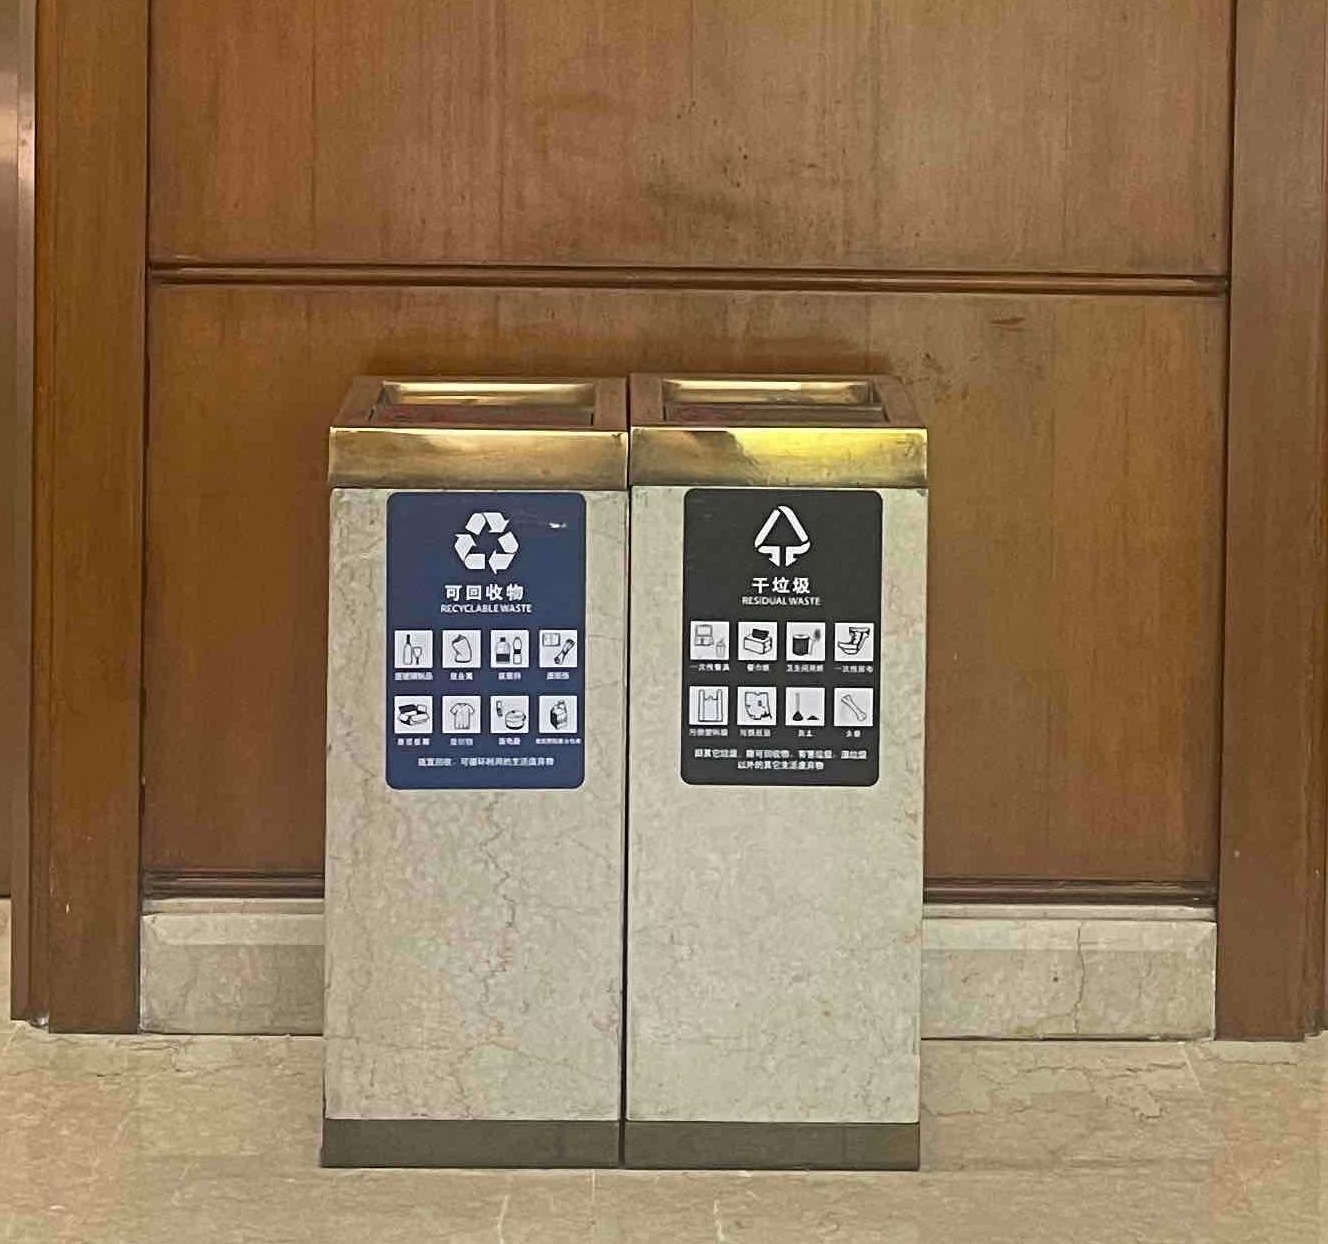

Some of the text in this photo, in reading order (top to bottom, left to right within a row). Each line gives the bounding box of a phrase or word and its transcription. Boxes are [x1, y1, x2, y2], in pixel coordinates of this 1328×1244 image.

[444, 584, 524, 602] 可回收物
[751, 577, 811, 595] 干垃圾
[440, 603, 533, 614] RECYCLABLE WASTE
[741, 595, 822, 607] RESIDUAL WASTE
